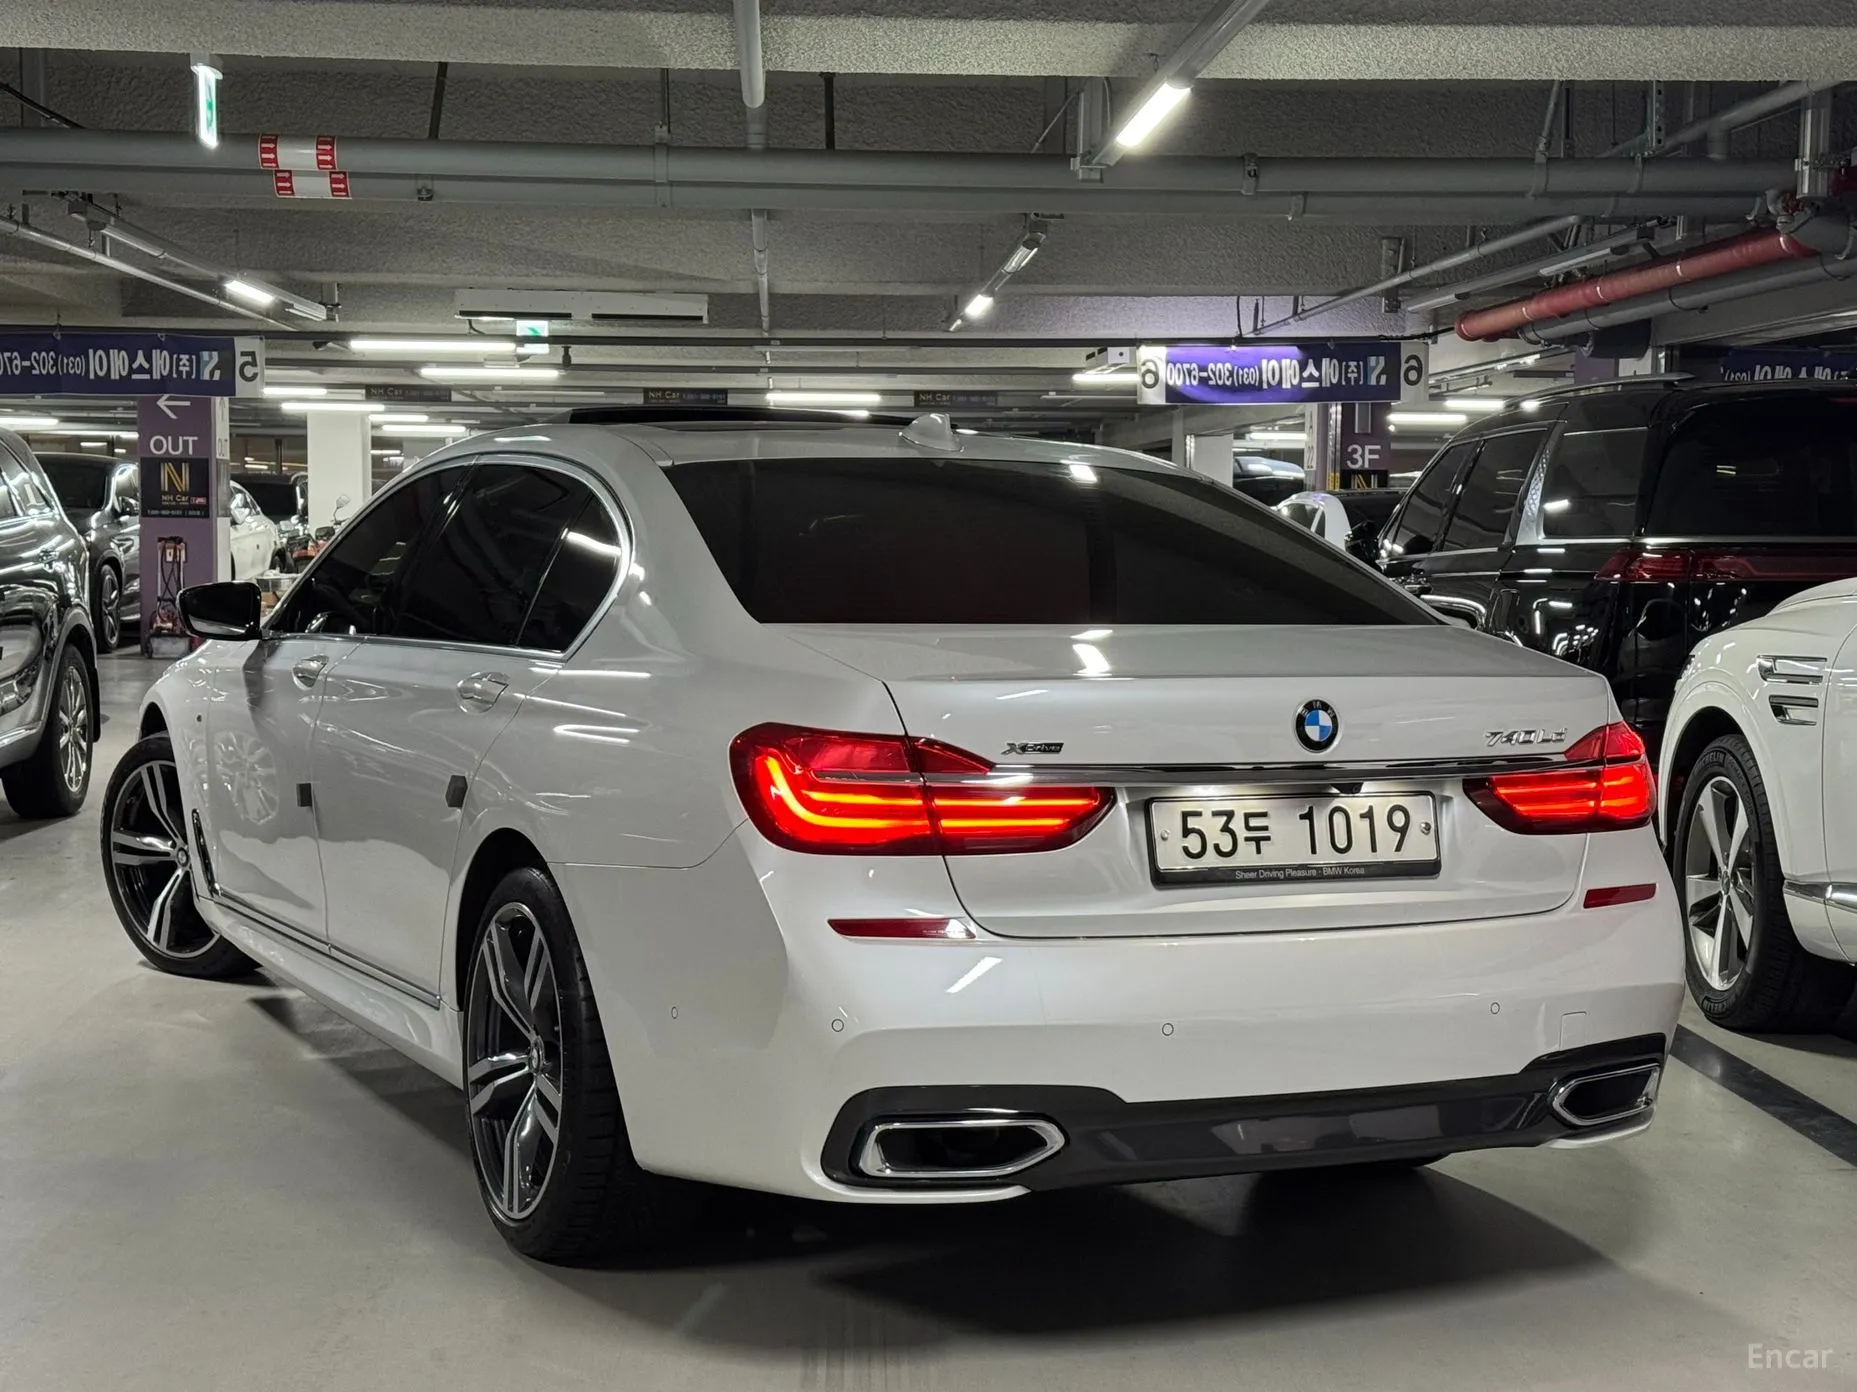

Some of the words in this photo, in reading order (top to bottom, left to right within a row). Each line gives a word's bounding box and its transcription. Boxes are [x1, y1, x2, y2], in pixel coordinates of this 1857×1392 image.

[149, 435, 199, 455] OUT
[1346, 444, 1381, 469] 3F
[161, 462, 190, 492] N
[1180, 808, 1272, 860] 53두
[1298, 803, 1411, 855] 1019
[1235, 870, 1258, 880] Sheer
[1259, 869, 1285, 879] Driving
[1285, 868, 1317, 878] Pleasure
[1322, 866, 1342, 876] BMW
[1343, 866, 1366, 875] Korea
